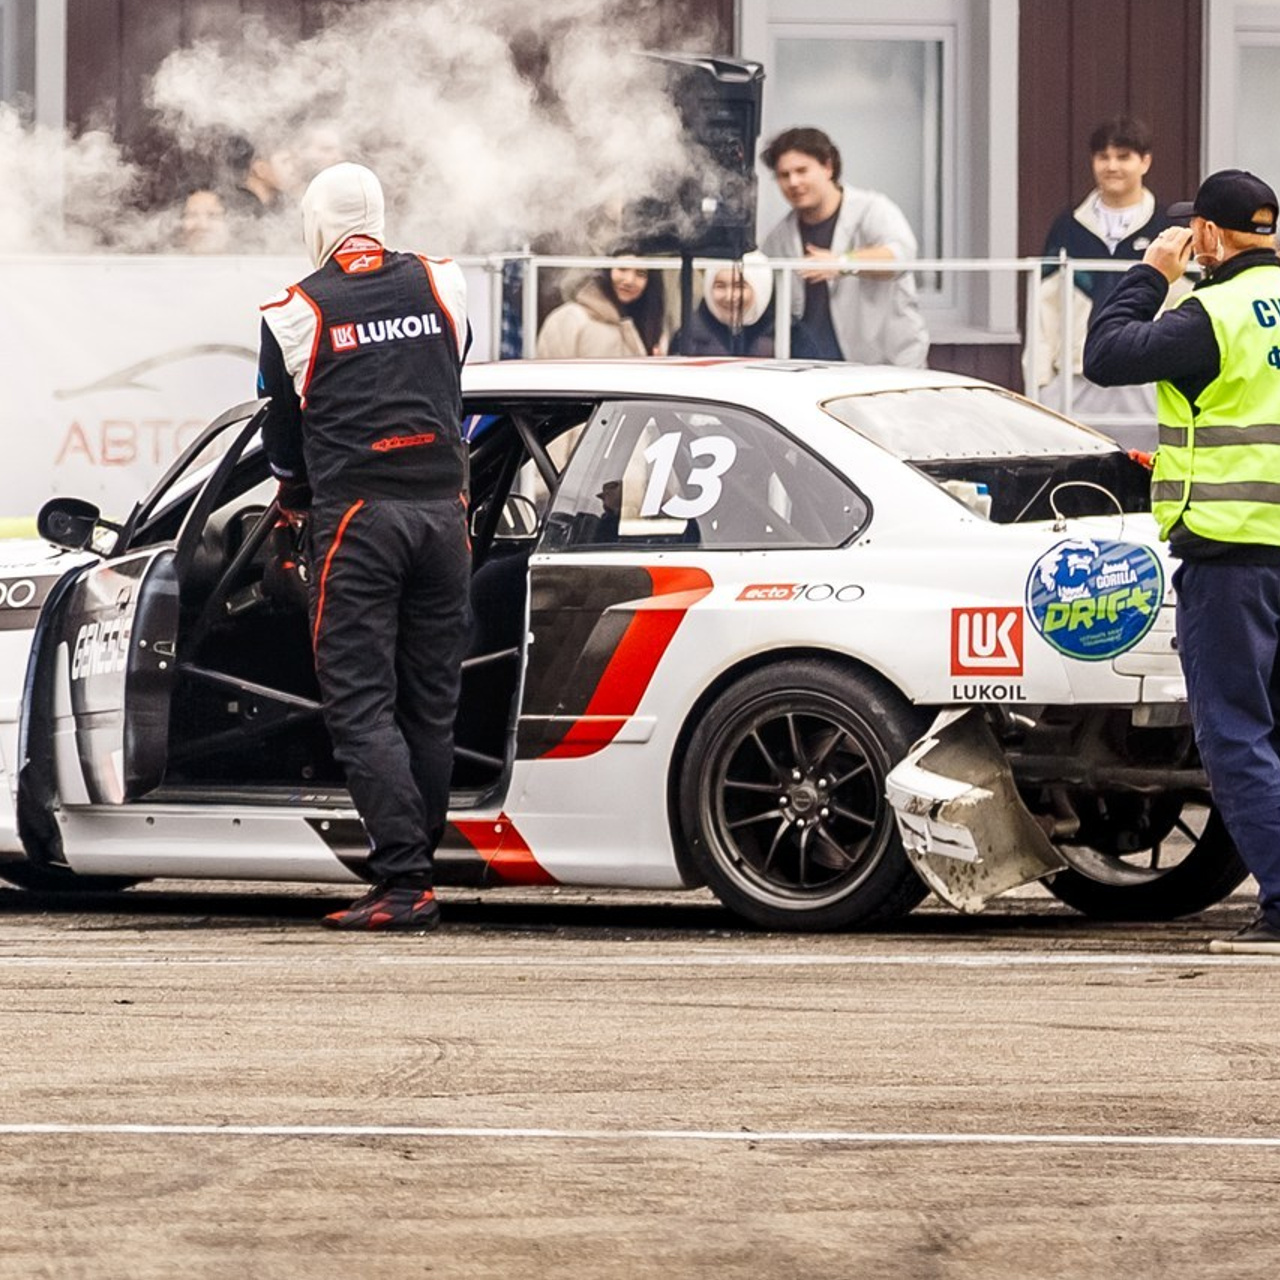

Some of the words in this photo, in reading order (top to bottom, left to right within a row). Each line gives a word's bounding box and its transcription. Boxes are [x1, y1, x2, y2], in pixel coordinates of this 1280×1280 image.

[356, 313, 442, 344] LUKOIL
[640, 431, 737, 519] 13
[1096, 569, 1138, 589] GORILLA
[952, 684, 1027, 700] LUKOIL
